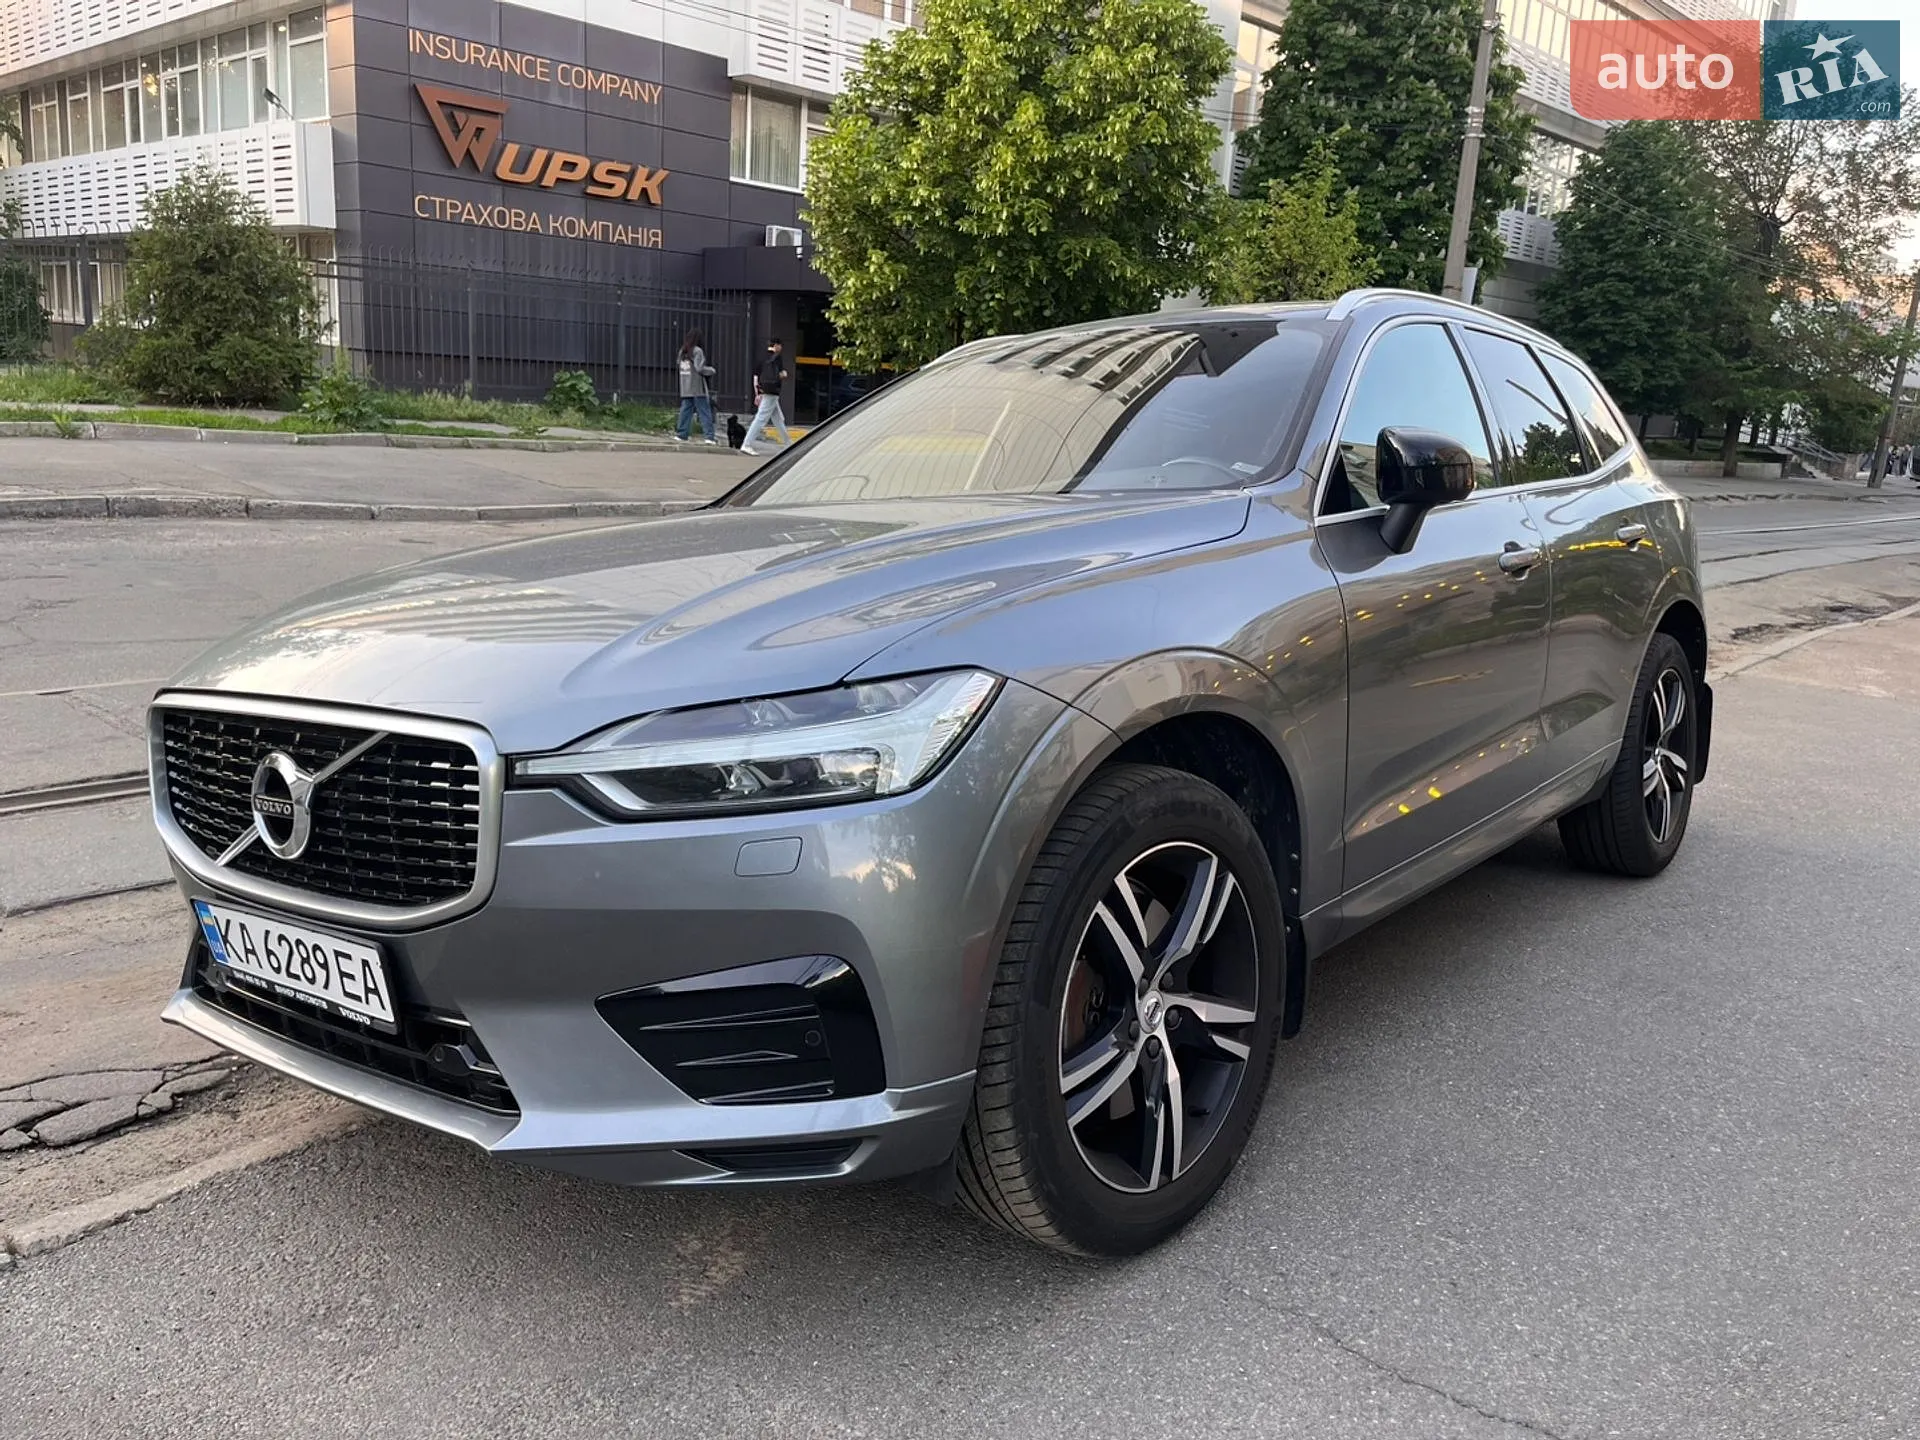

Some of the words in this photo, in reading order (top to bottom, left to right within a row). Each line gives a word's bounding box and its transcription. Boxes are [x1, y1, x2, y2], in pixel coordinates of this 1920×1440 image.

[408, 28, 551, 82] INSURANCE
[557, 63, 663, 105] COMPANY
[495, 143, 670, 205] UPSK
[414, 194, 544, 235] СТРАХОВА
[549, 213, 664, 249] КОМПАНІЯ
[254, 799, 292, 815] VOLVO
[264, 930, 330, 991] 6289
